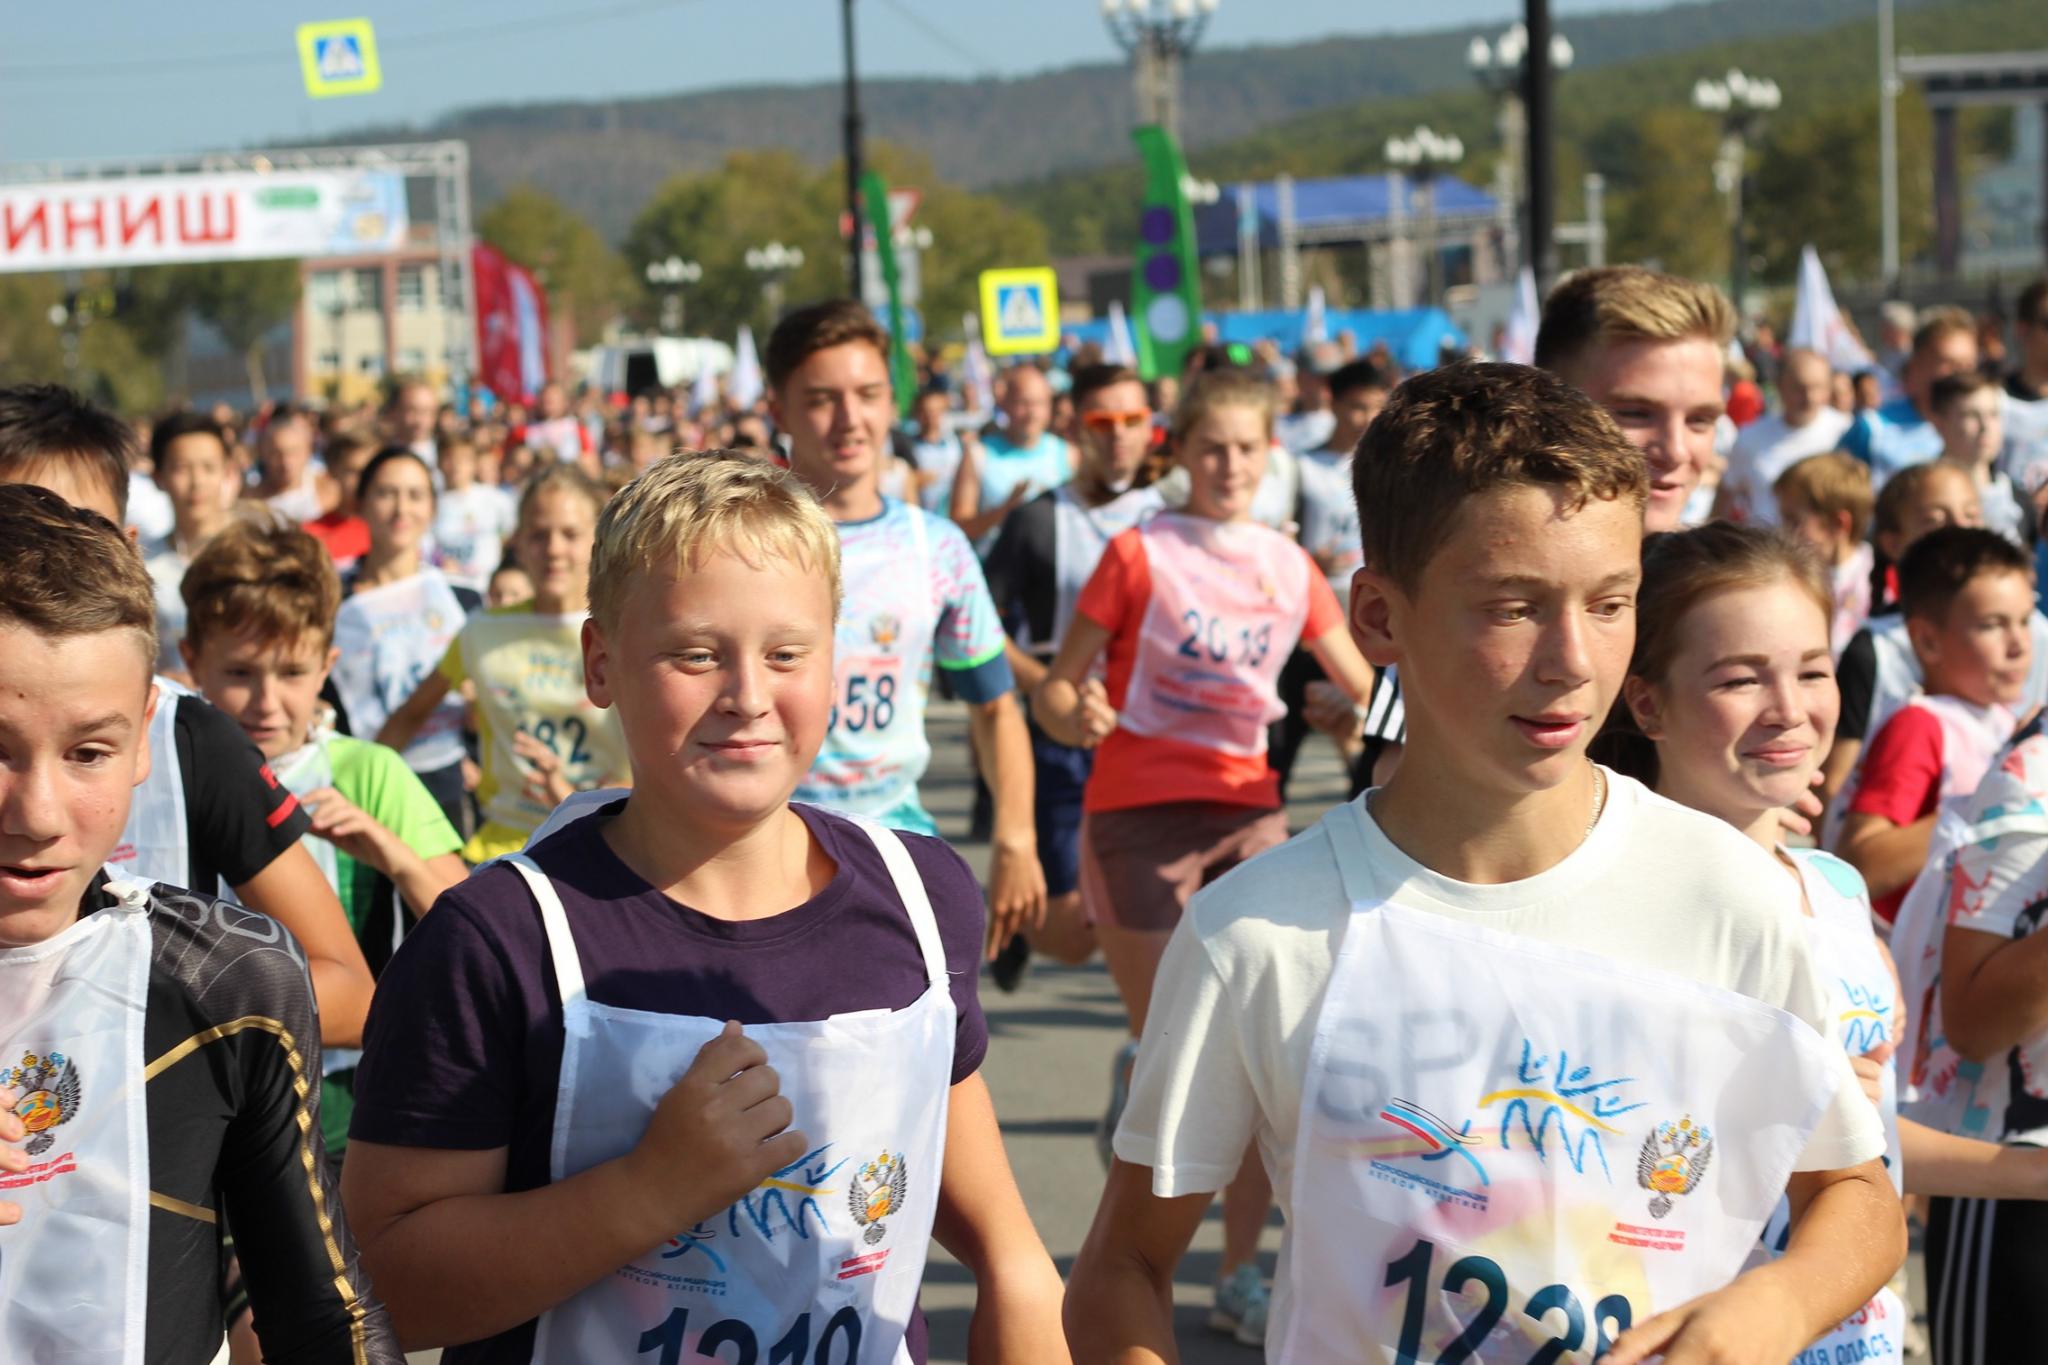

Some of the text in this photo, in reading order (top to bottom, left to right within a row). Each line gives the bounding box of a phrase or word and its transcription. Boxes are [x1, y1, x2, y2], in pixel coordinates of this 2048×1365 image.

[4, 191, 238, 253] ИНИШ
[1178, 610, 1271, 667] 2019
[828, 674, 895, 732] 58
[516, 716, 591, 763] 82
